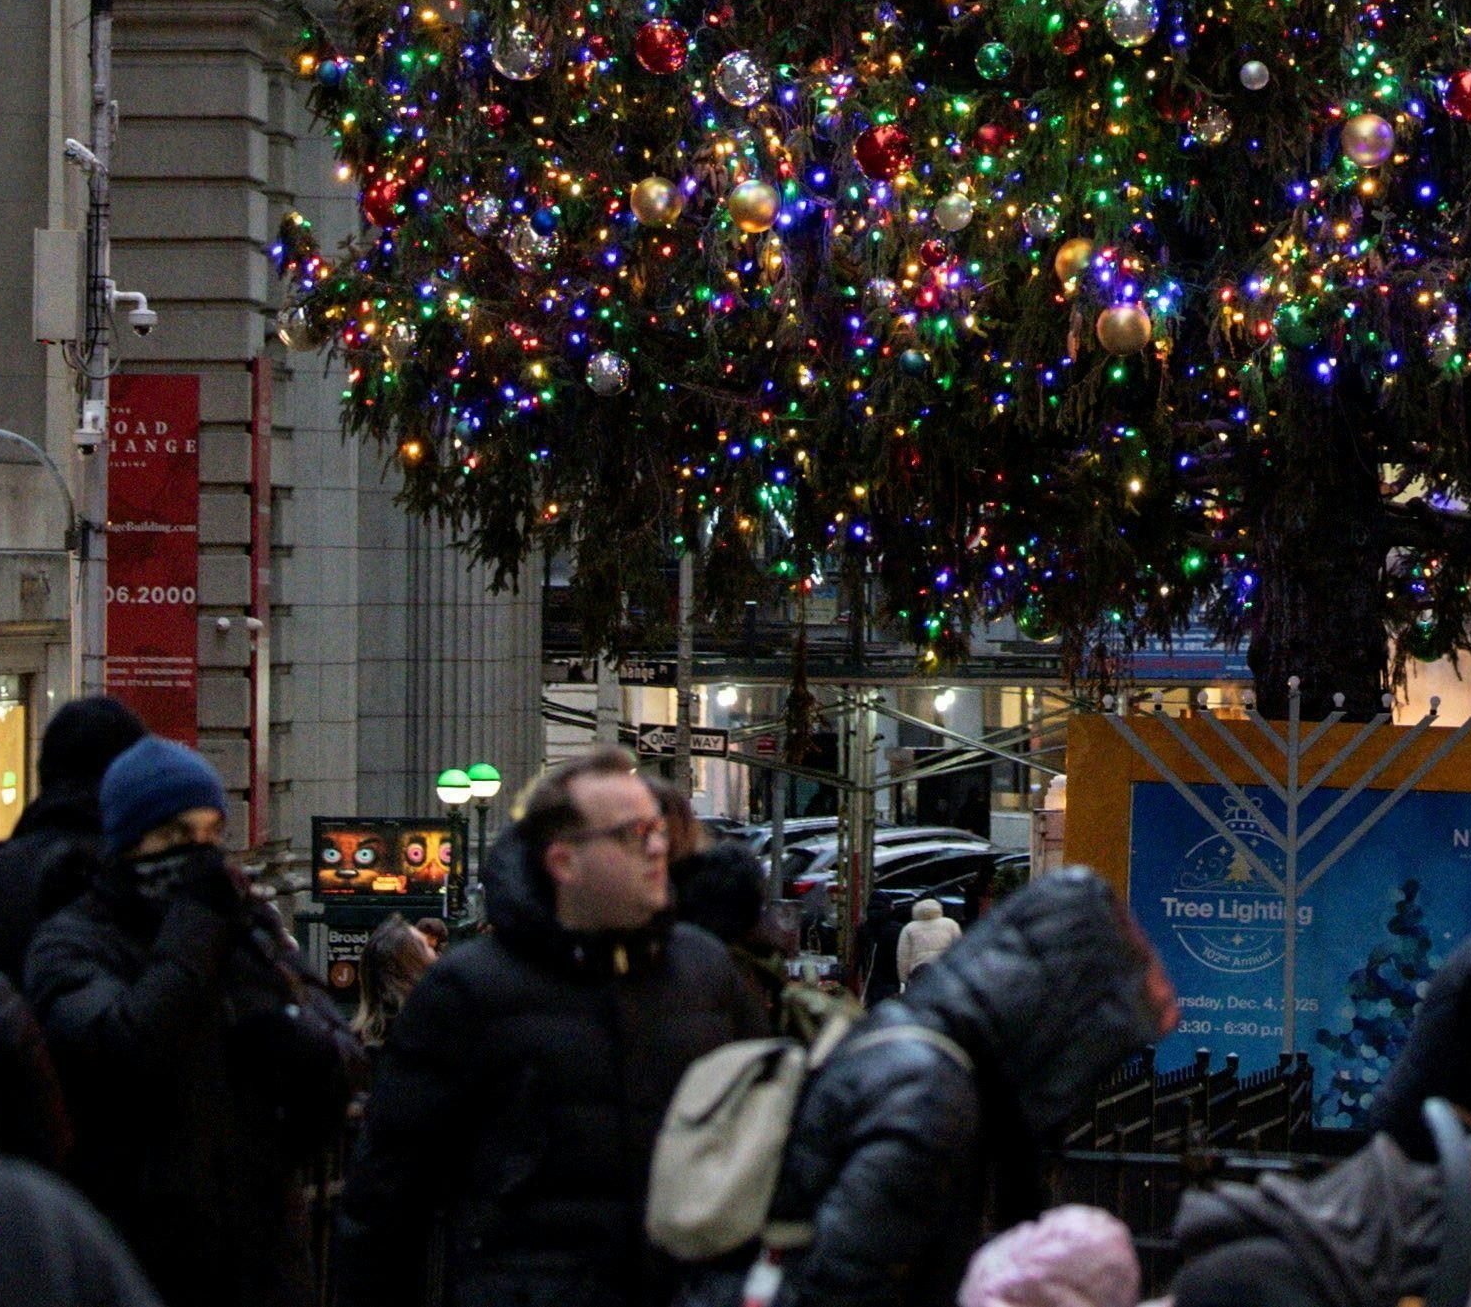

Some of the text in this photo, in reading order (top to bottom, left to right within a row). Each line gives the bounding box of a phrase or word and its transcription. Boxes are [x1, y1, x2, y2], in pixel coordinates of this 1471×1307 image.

[114, 420, 169, 435] OAD
[110, 439, 197, 454] HANGE
[107, 586, 197, 605] 06.2000
[620, 663, 656, 684] hange
[651, 732, 720, 749] ONE WAY
[1160, 896, 1314, 926] Tree Lightig
[329, 930, 369, 944] Broad
[337, 967, 349, 982] J
[1176, 995, 1224, 1011] ursday,
[1227, 995, 1260, 1010] Dec.
